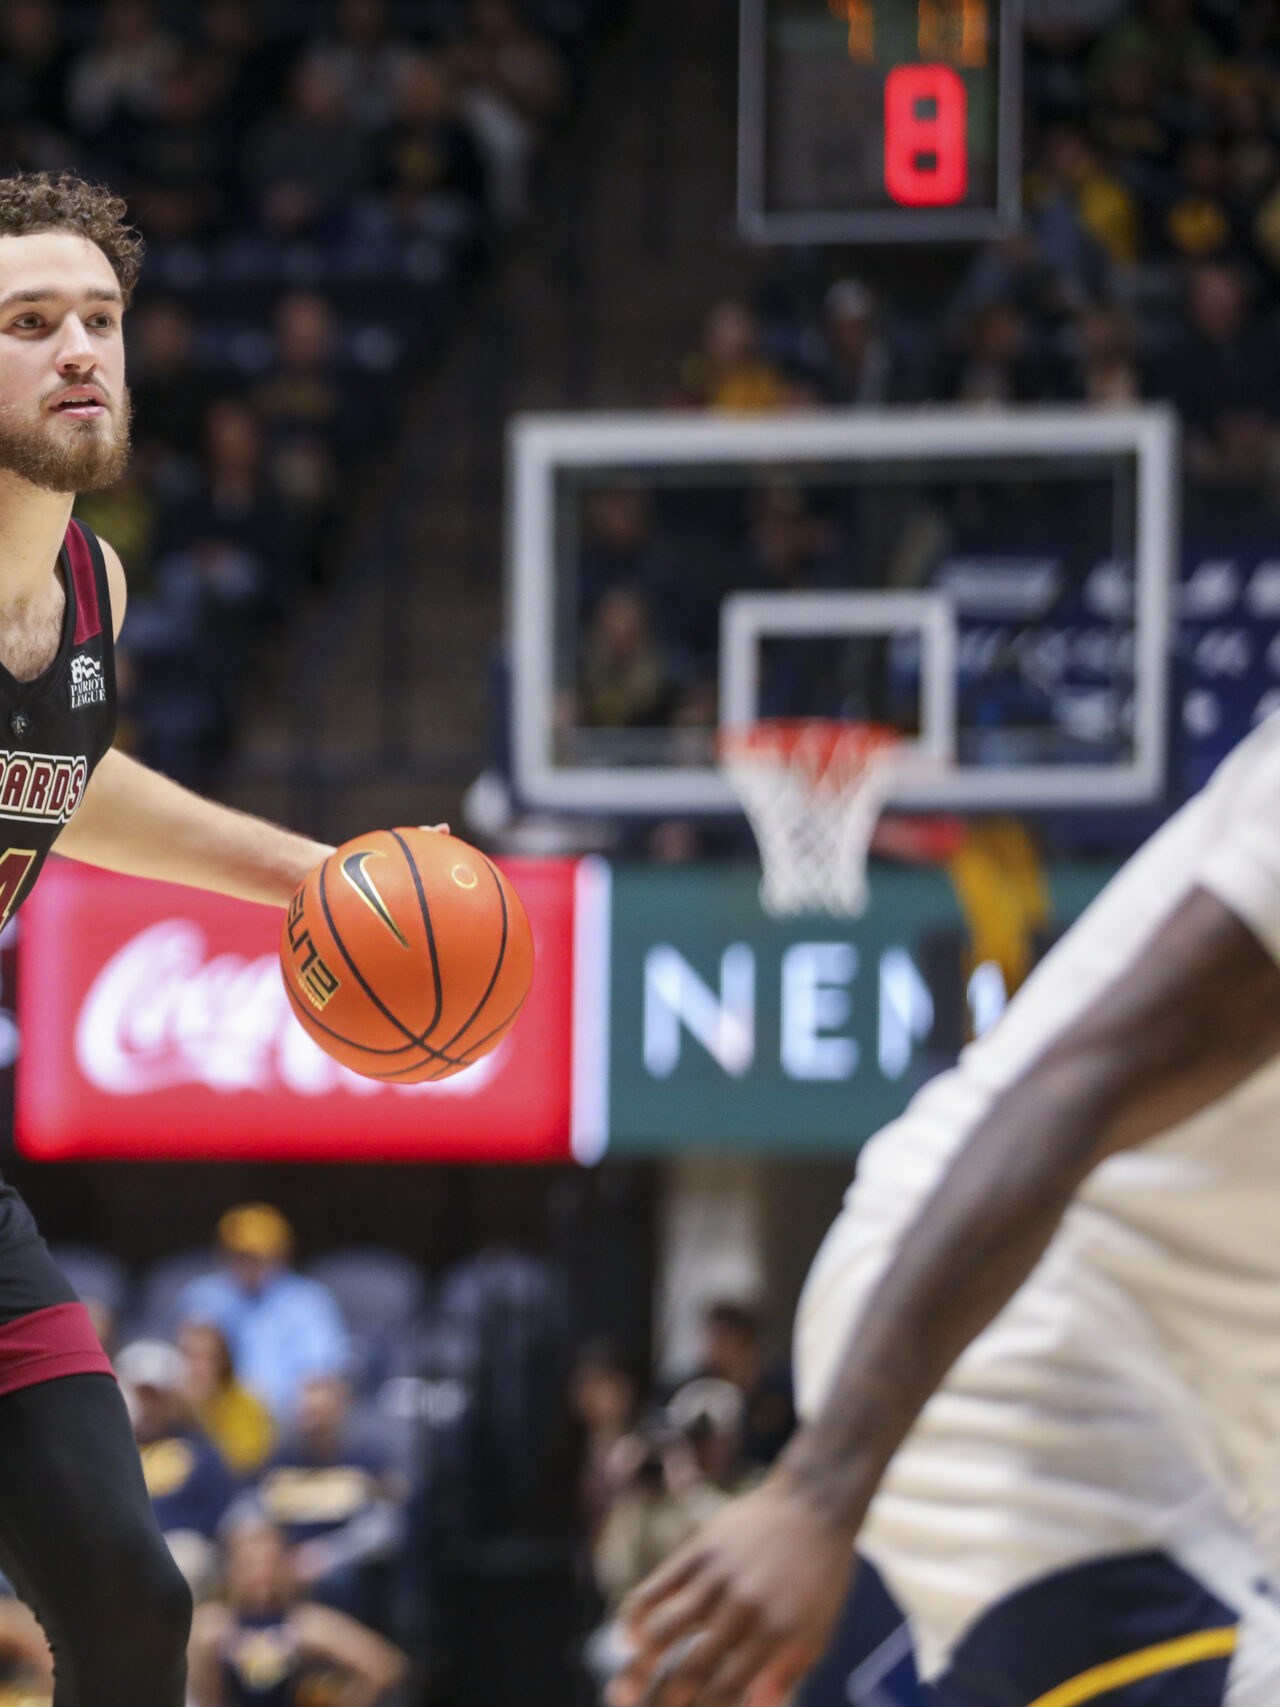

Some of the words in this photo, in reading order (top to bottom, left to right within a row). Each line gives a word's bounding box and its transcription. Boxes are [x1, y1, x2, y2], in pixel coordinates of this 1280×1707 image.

[883, 62, 967, 208] 8
[70, 677, 104, 697] PATRIOT
[71, 689, 106, 709] LEAGUE
